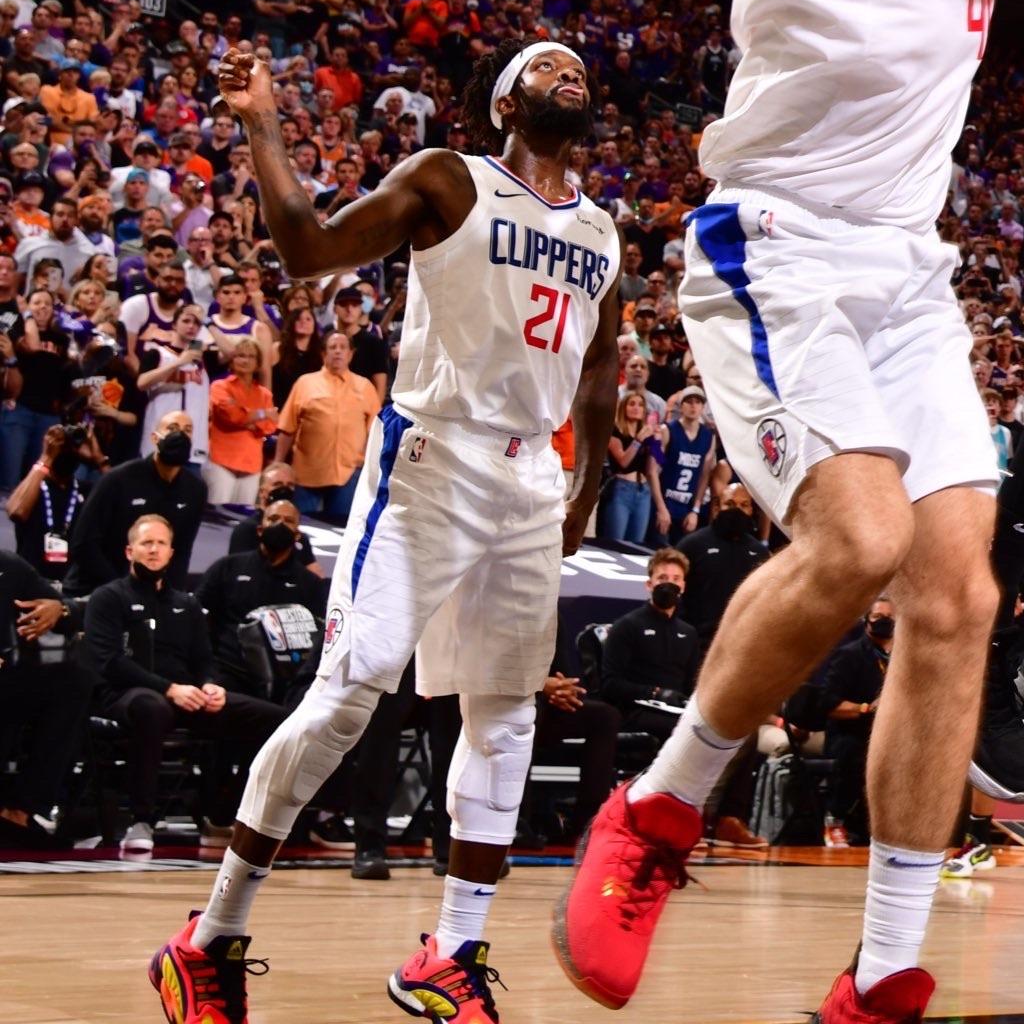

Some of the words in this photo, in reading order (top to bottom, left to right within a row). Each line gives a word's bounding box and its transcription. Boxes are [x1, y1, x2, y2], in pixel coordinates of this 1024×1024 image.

[489, 217, 609, 301] CLIPPERS
[524, 283, 571, 354] 21
[676, 469, 693, 491] 2
